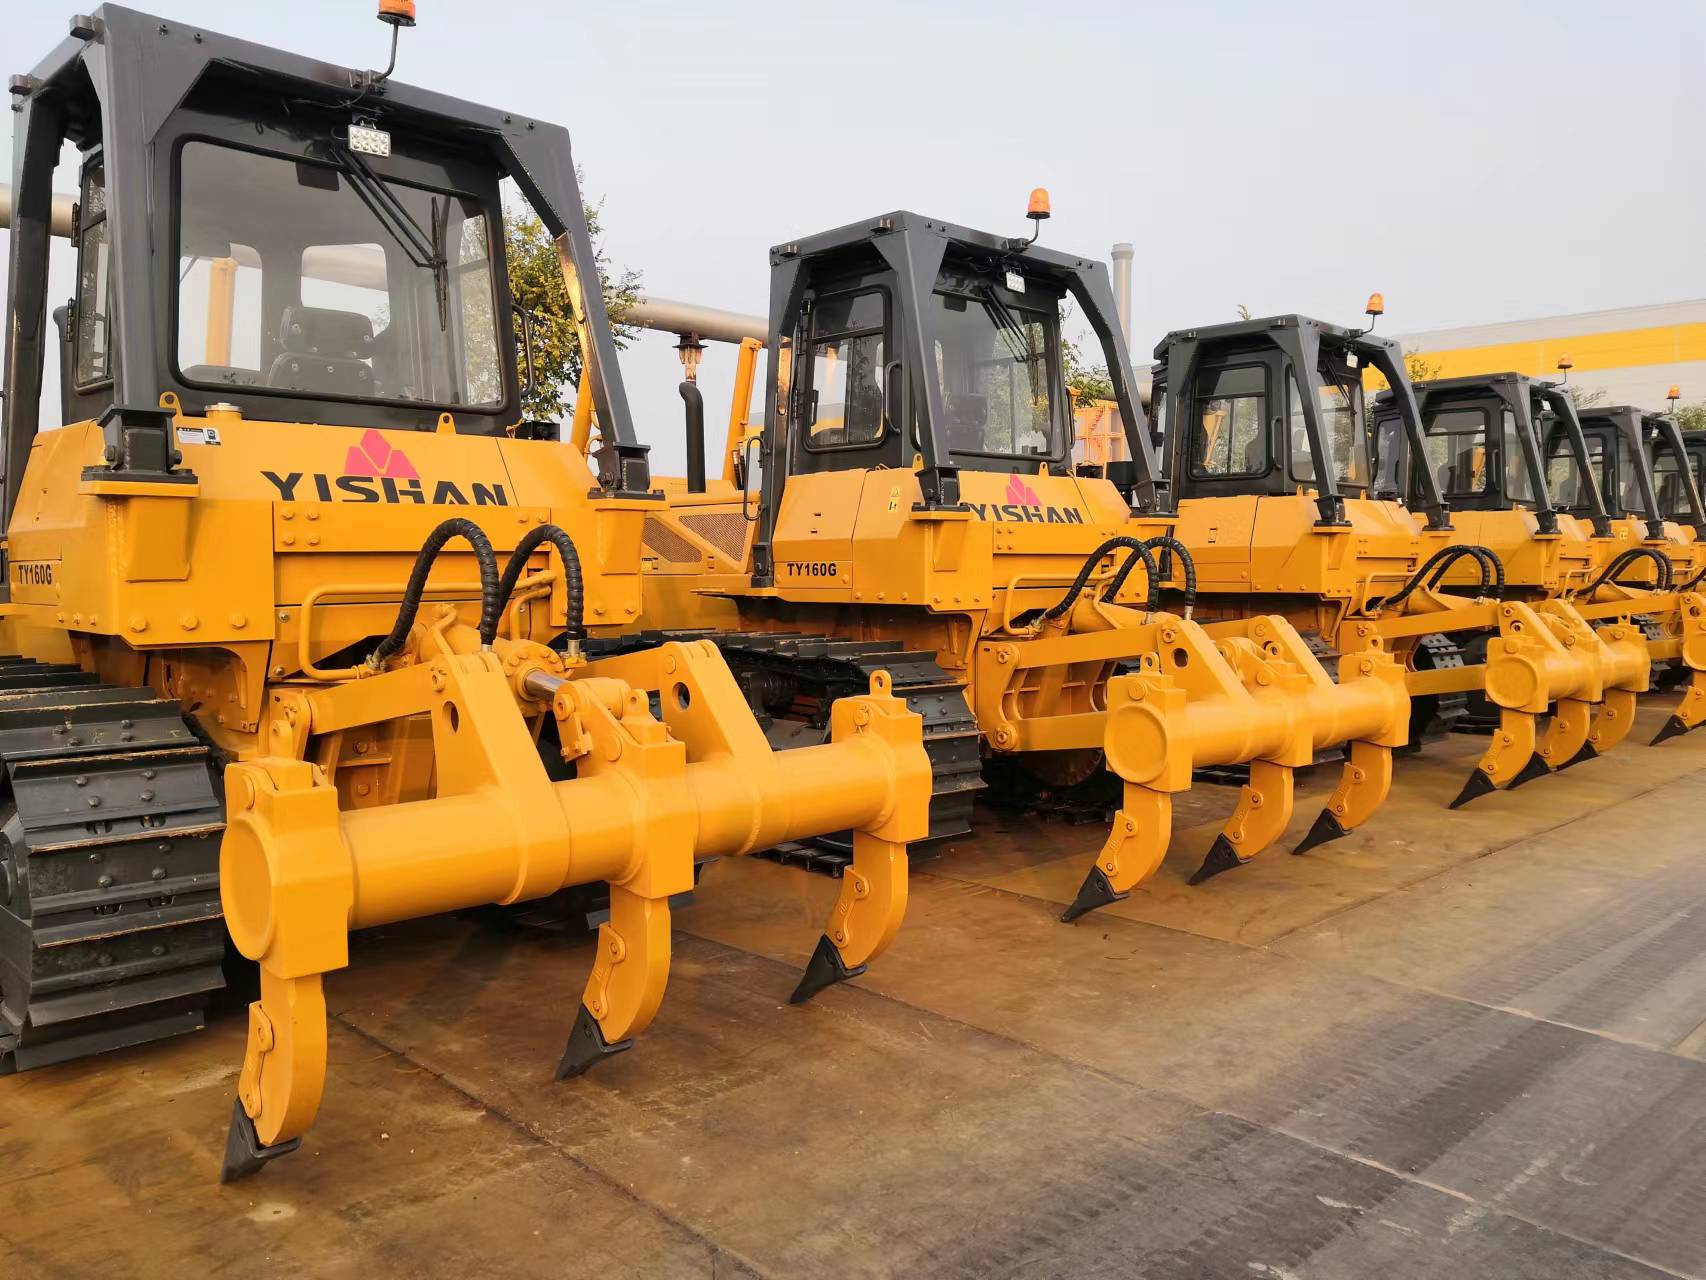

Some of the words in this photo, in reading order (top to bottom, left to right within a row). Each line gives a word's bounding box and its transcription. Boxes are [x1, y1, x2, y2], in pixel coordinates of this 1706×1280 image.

[260, 470, 508, 506] YISHAN
[968, 503, 1083, 524] YISHAN
[18, 564, 52, 585] TY160G
[787, 562, 837, 576] TY160G
